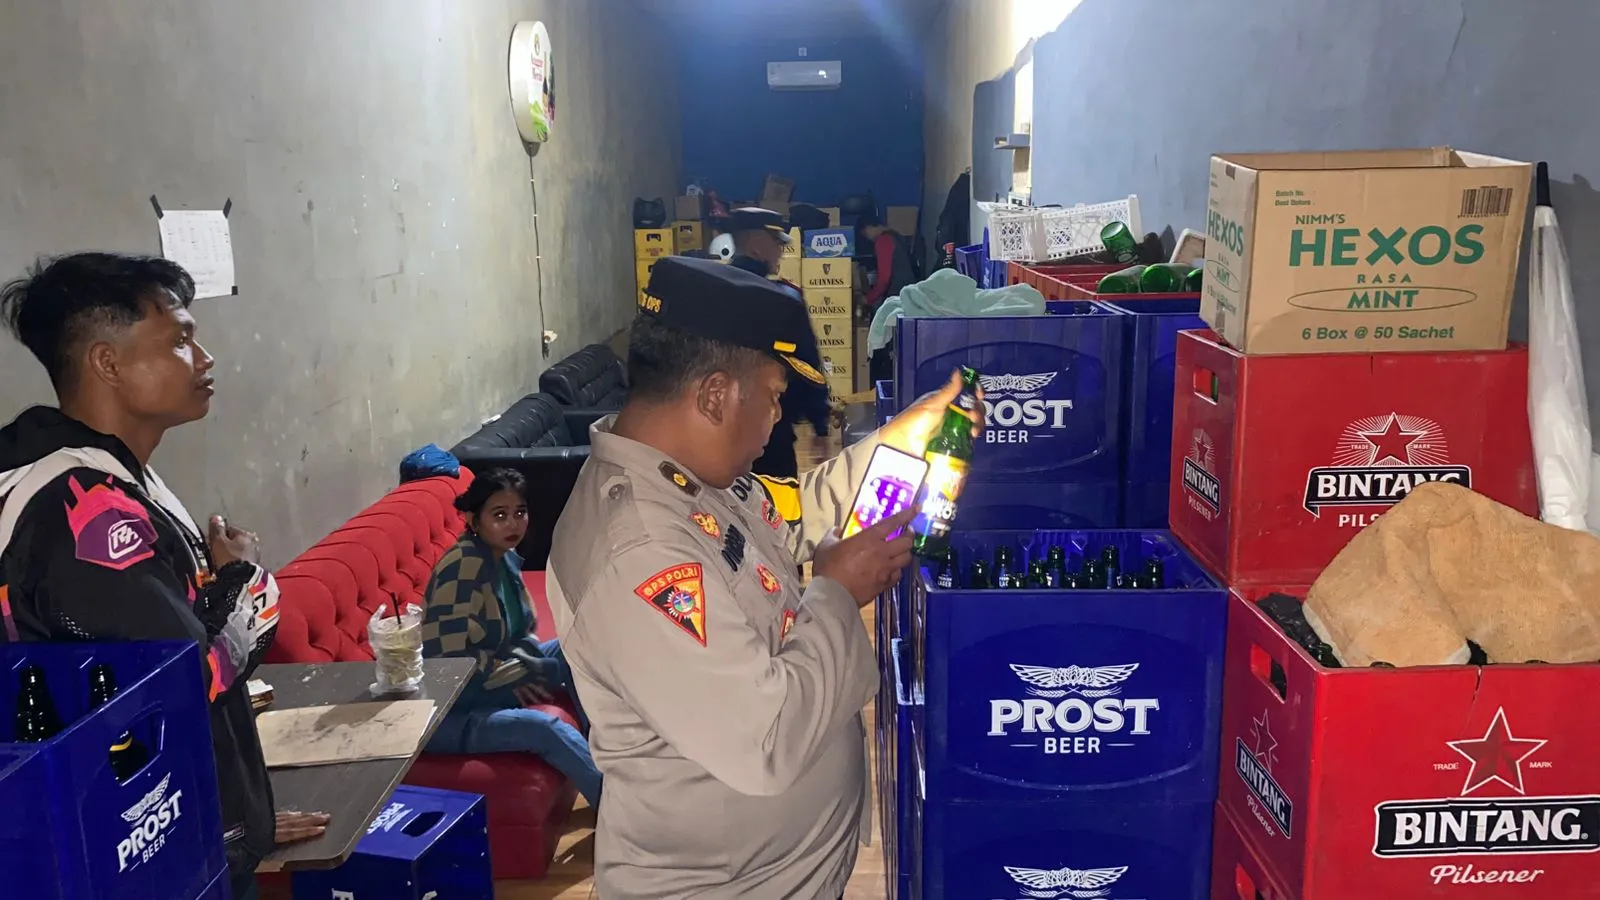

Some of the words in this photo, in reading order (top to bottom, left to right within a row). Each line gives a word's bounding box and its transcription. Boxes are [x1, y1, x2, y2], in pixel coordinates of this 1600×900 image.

[1295, 213, 1346, 225] NIMM'S
[816, 236, 842, 248] AQUA
[1208, 209, 1244, 257] HEXOS
[1289, 224, 1485, 267] HEXOS
[809, 278, 844, 286] GUINNESS
[1357, 273, 1412, 284] RASA
[808, 305, 846, 314] GUINNESS
[1347, 289, 1419, 309] MINT
[1302, 328, 1311, 340] 6
[1316, 327, 1348, 340] Box
[1354, 327, 1368, 340] @
[1373, 327, 1393, 339] 50
[1398, 326, 1454, 339] Sachet
[983, 399, 1073, 429] ROST
[986, 430, 1028, 443] BEER
[1185, 462, 1219, 503] BINTANG
[643, 577, 666, 597] OPS
[666, 567, 698, 583] POLRI
[987, 698, 1160, 736] PROST
[1044, 737, 1101, 754] BEER
[1433, 762, 1459, 770] TRADE
[1529, 761, 1552, 769] MARK
[1240, 748, 1286, 823] BINTANG
[116, 789, 182, 873] PROST
[1393, 807, 1581, 846] BINTANG
[142, 833, 166, 864] BEER
[1430, 864, 1544, 885] Pilsener
